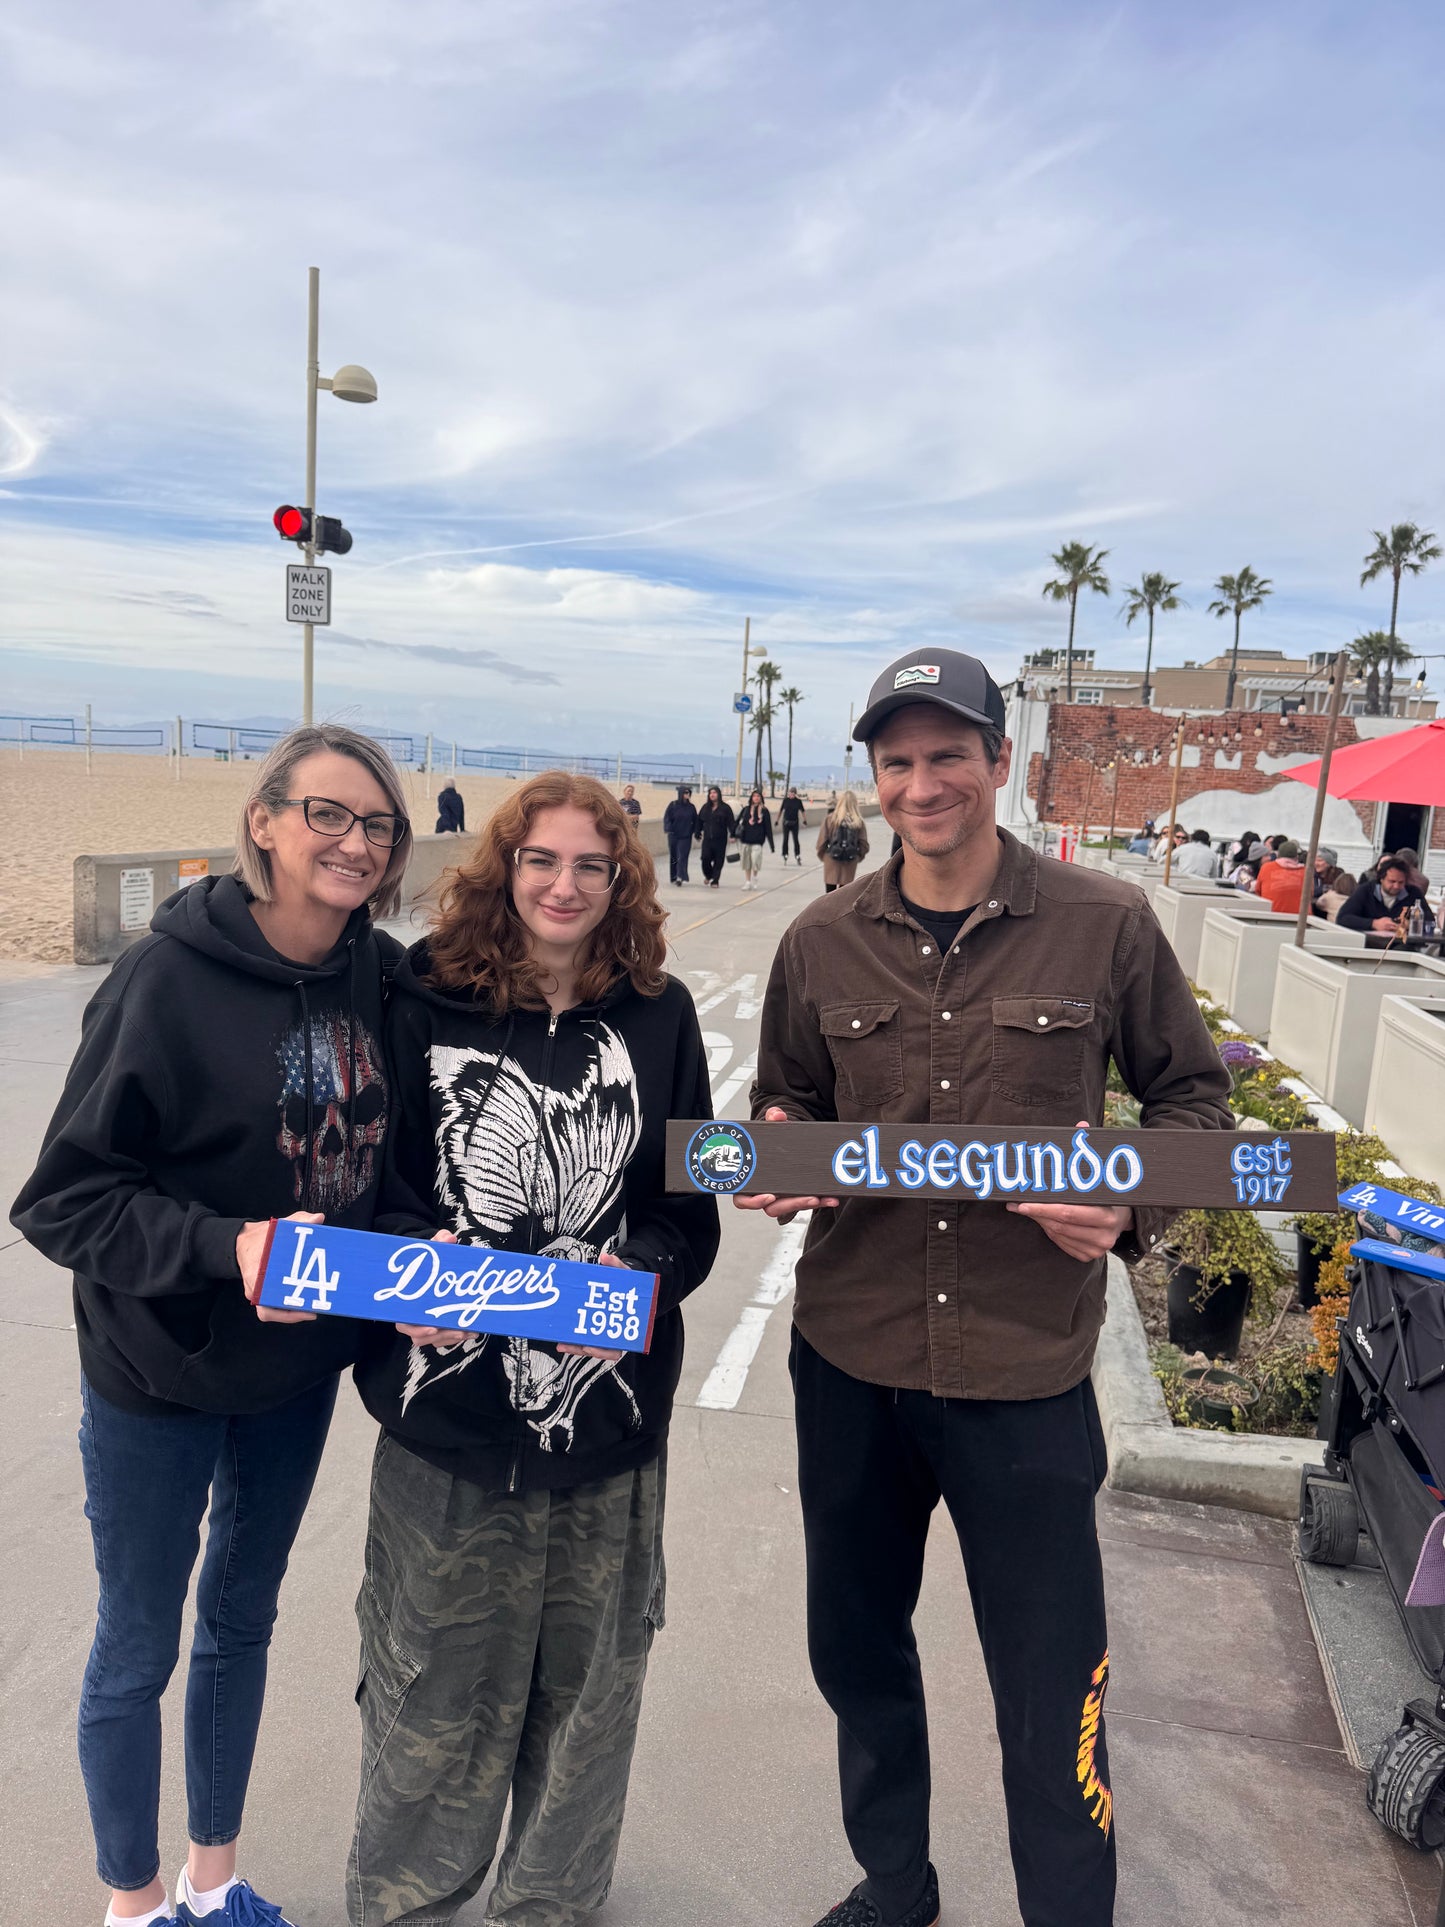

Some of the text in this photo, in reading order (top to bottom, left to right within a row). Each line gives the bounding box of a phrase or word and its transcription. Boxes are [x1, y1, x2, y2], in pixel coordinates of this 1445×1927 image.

[291, 572, 325, 585] WALK
[292, 588, 324, 601] ZONE
[292, 604, 323, 617] ONLY
[698, 1126, 743, 1140] CITY OF
[1231, 1136, 1292, 1174] est
[691, 1164, 750, 1191] EL SEGUNDO
[1230, 1174, 1293, 1206] 1917
[1347, 1185, 1445, 1229] LA Vin
[282, 1226, 340, 1312] LA
[373, 1243, 560, 1328] Dodgers
[587, 1281, 639, 1315] Est
[574, 1308, 640, 1342] 1958
